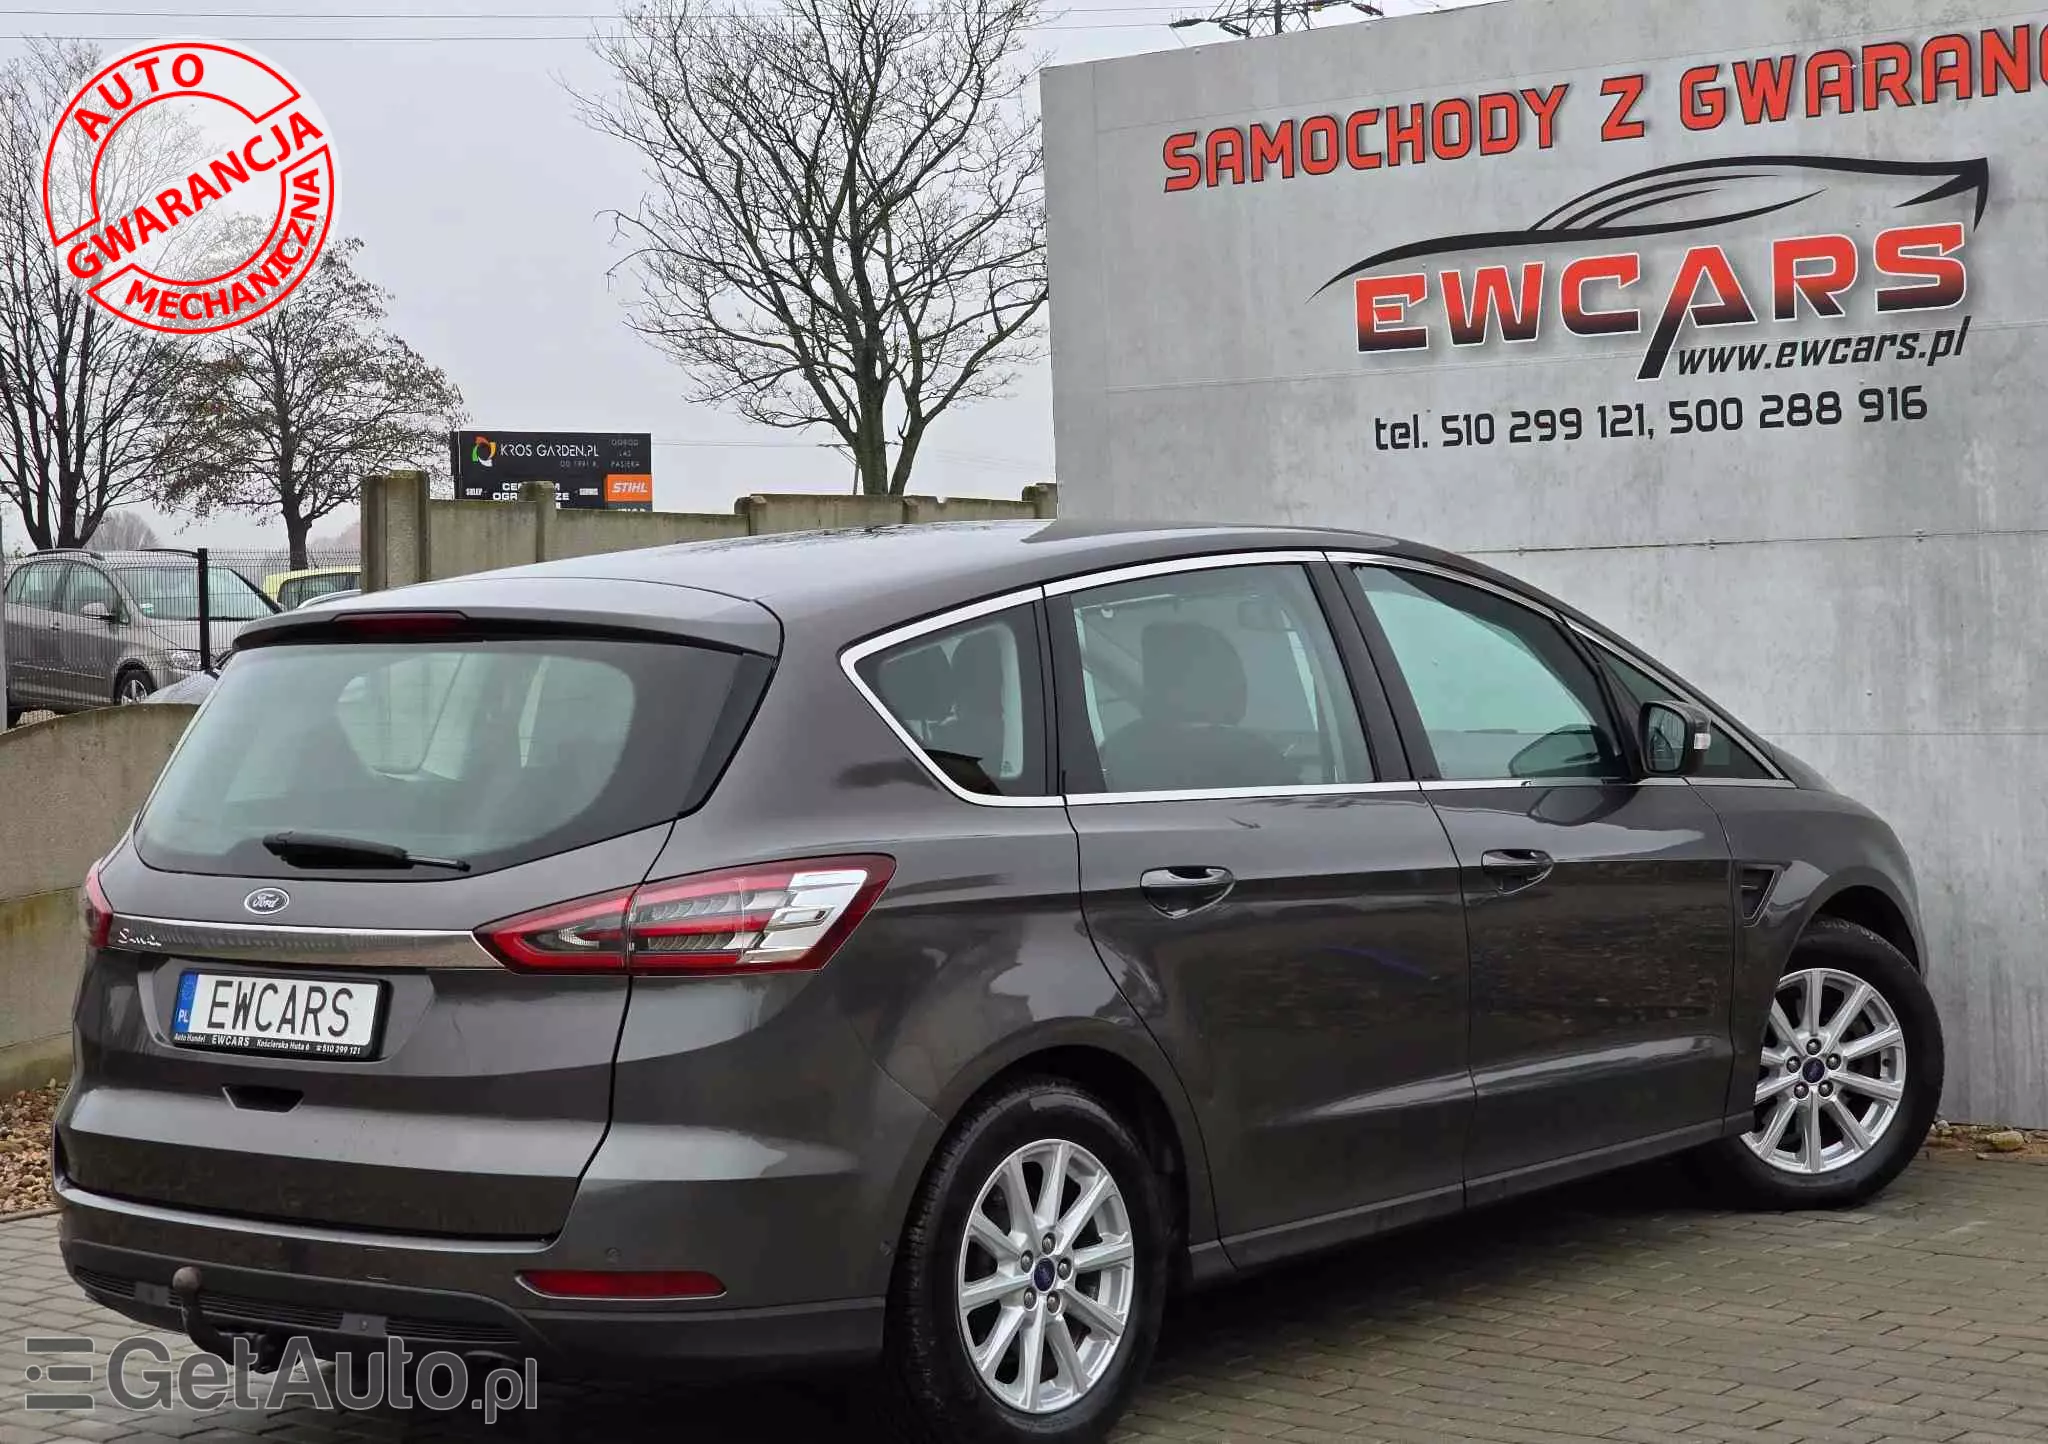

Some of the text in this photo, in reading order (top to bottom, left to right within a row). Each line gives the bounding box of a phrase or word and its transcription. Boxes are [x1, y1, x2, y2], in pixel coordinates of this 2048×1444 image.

[1162, 24, 2048, 193] SAMOCHODY Z GWARAN
[1354, 222, 1967, 380] EWCARS
[1677, 316, 1968, 377] www.ewcars.pl
[1375, 385, 1928, 451] tel. 510 299 121, 500 288 916
[500, 443, 599, 457] KROS GARDEN.PL
[612, 482, 648, 493] STIHL
[252, 892, 280, 908] Ford
[177, 1008, 189, 1023] PL
[207, 980, 354, 1037] EWCARS
[211, 1034, 250, 1047] EWCARS
[335, 1045, 347, 1054] 299
[349, 1046, 360, 1055] 121
